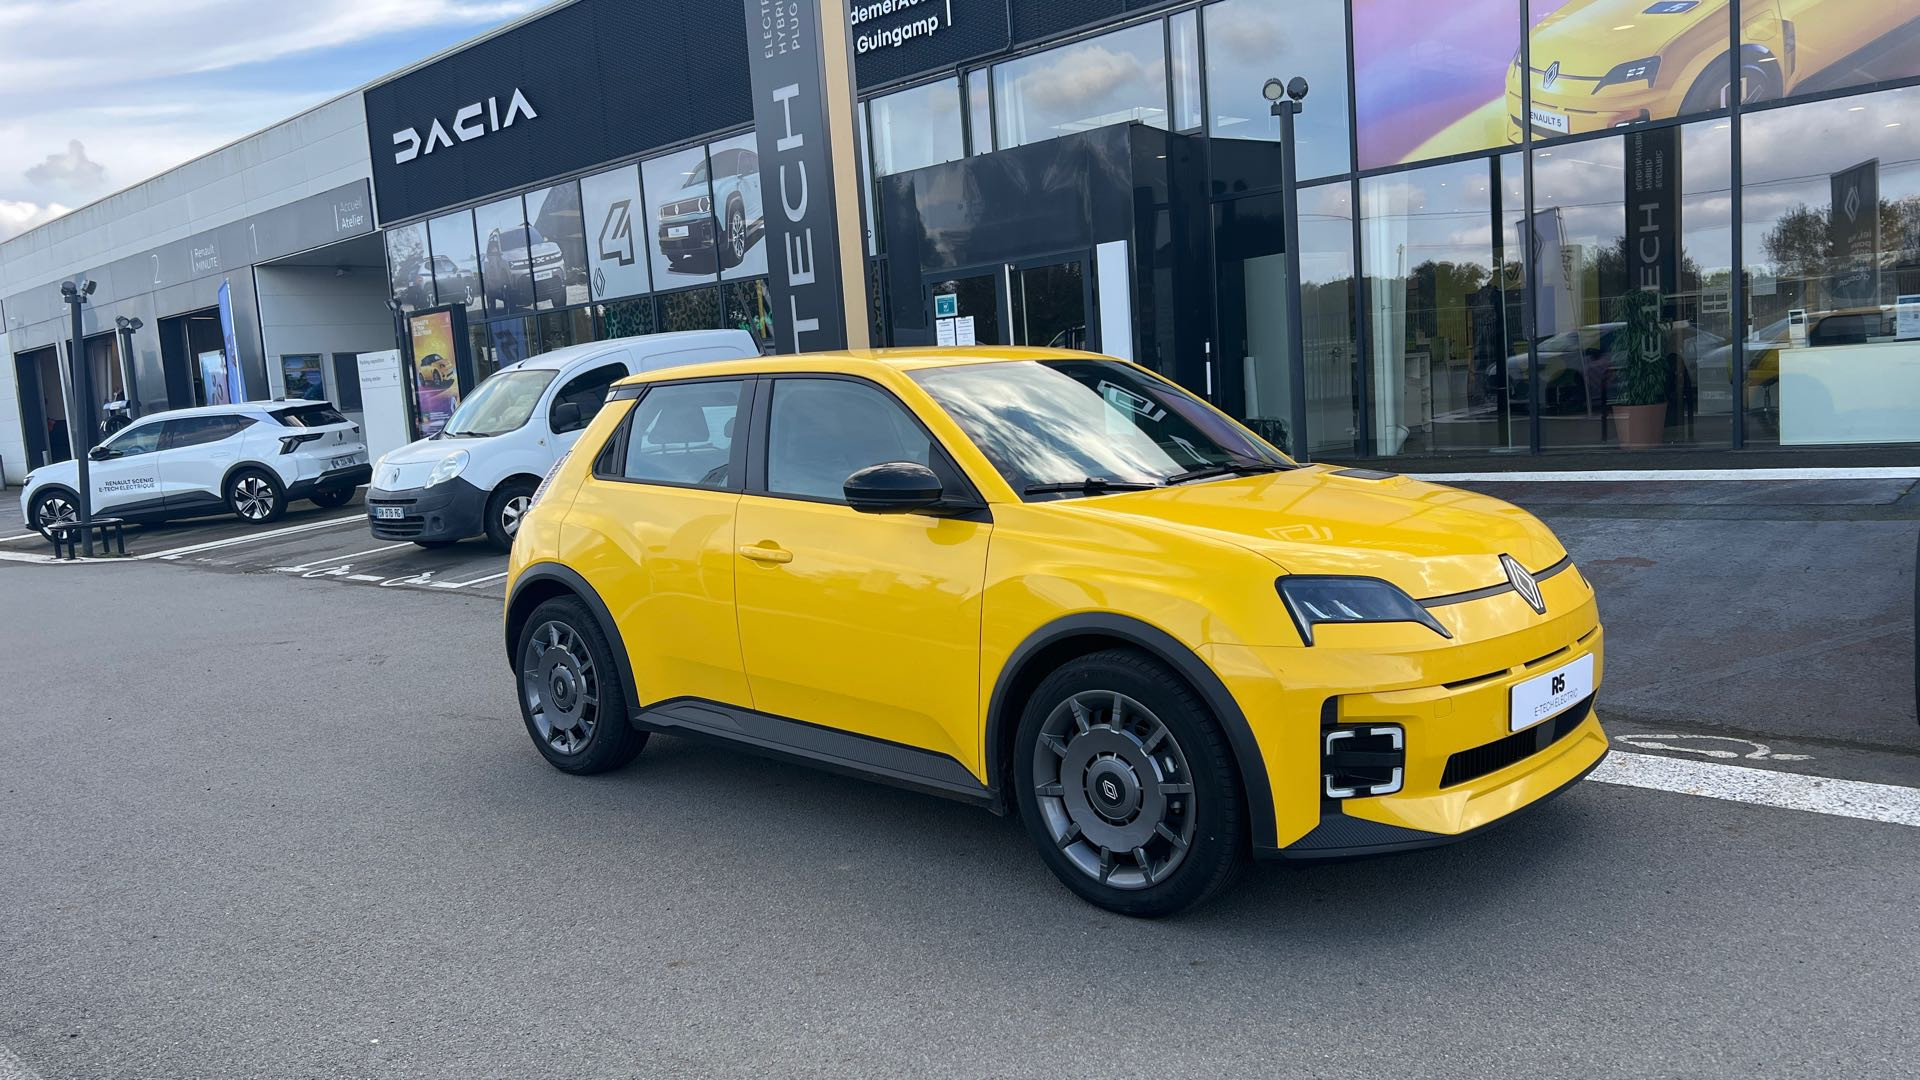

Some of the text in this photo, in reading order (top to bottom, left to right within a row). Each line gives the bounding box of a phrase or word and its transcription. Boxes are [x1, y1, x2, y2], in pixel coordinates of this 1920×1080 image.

[857, 16, 939, 53] Guingamp
[393, 87, 538, 165] DACIA
[1556, 118, 1562, 127] 5
[342, 215, 364, 230] Atelier
[772, 83, 820, 355] TECH
[194, 244, 215, 258] Renault
[250, 224, 258, 255] 1
[152, 254, 161, 284] 2
[195, 257, 218, 270] MINUTE
[1551, 672, 1566, 696] R5
[1534, 688, 1578, 717] E-TECH ELECTRIC
